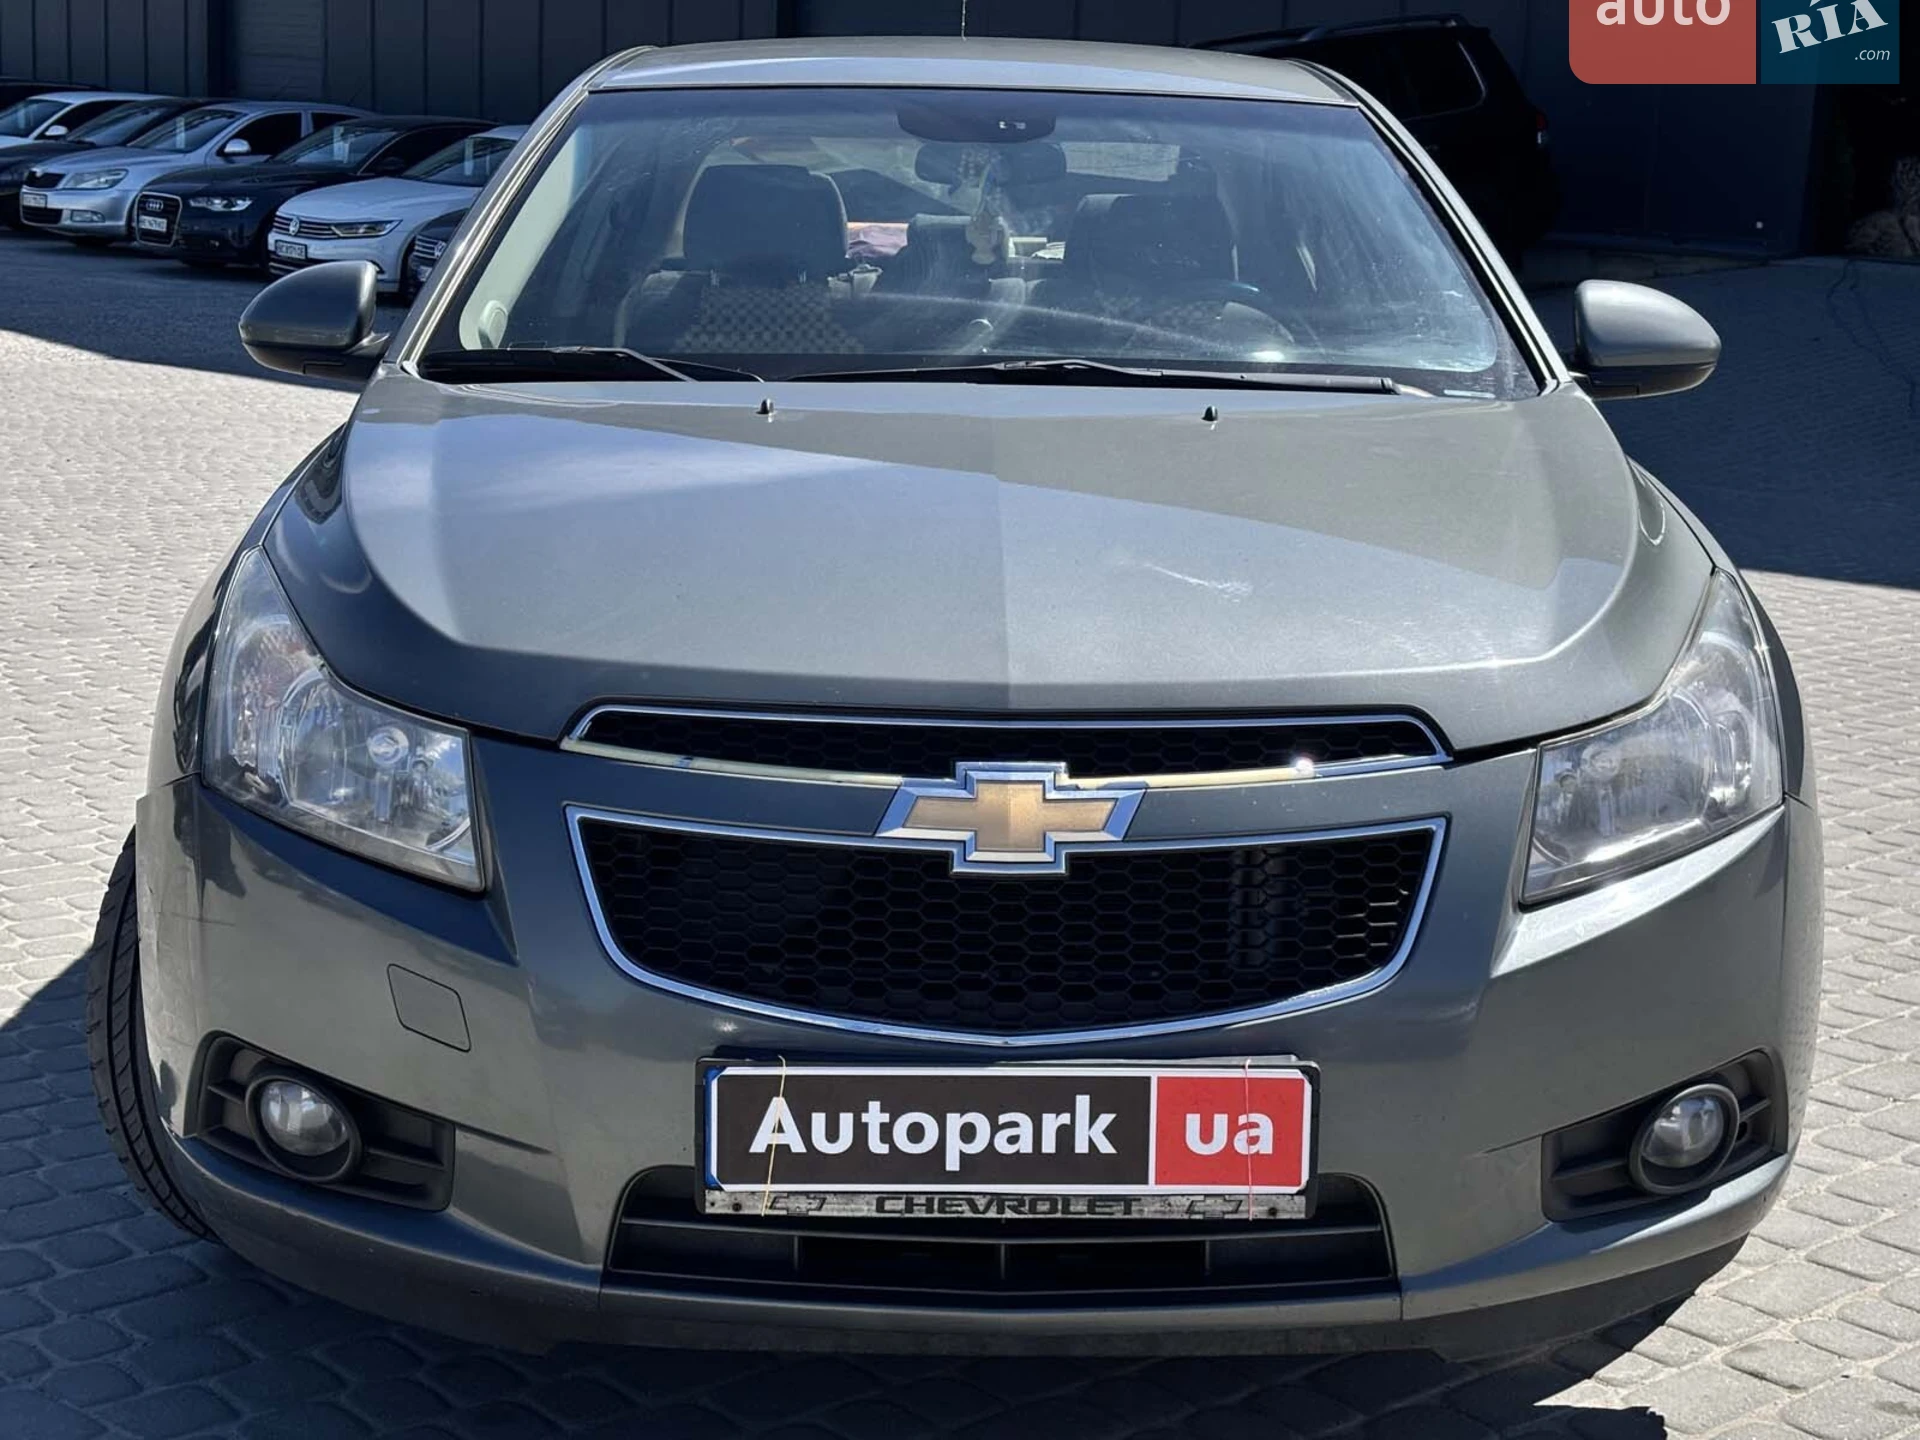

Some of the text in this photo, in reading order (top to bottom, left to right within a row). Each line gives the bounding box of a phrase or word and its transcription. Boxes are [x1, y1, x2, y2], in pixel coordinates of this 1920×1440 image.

[749, 1094, 1274, 1171] Autopark ua
[875, 1195, 1142, 1216] CHEVROLET
